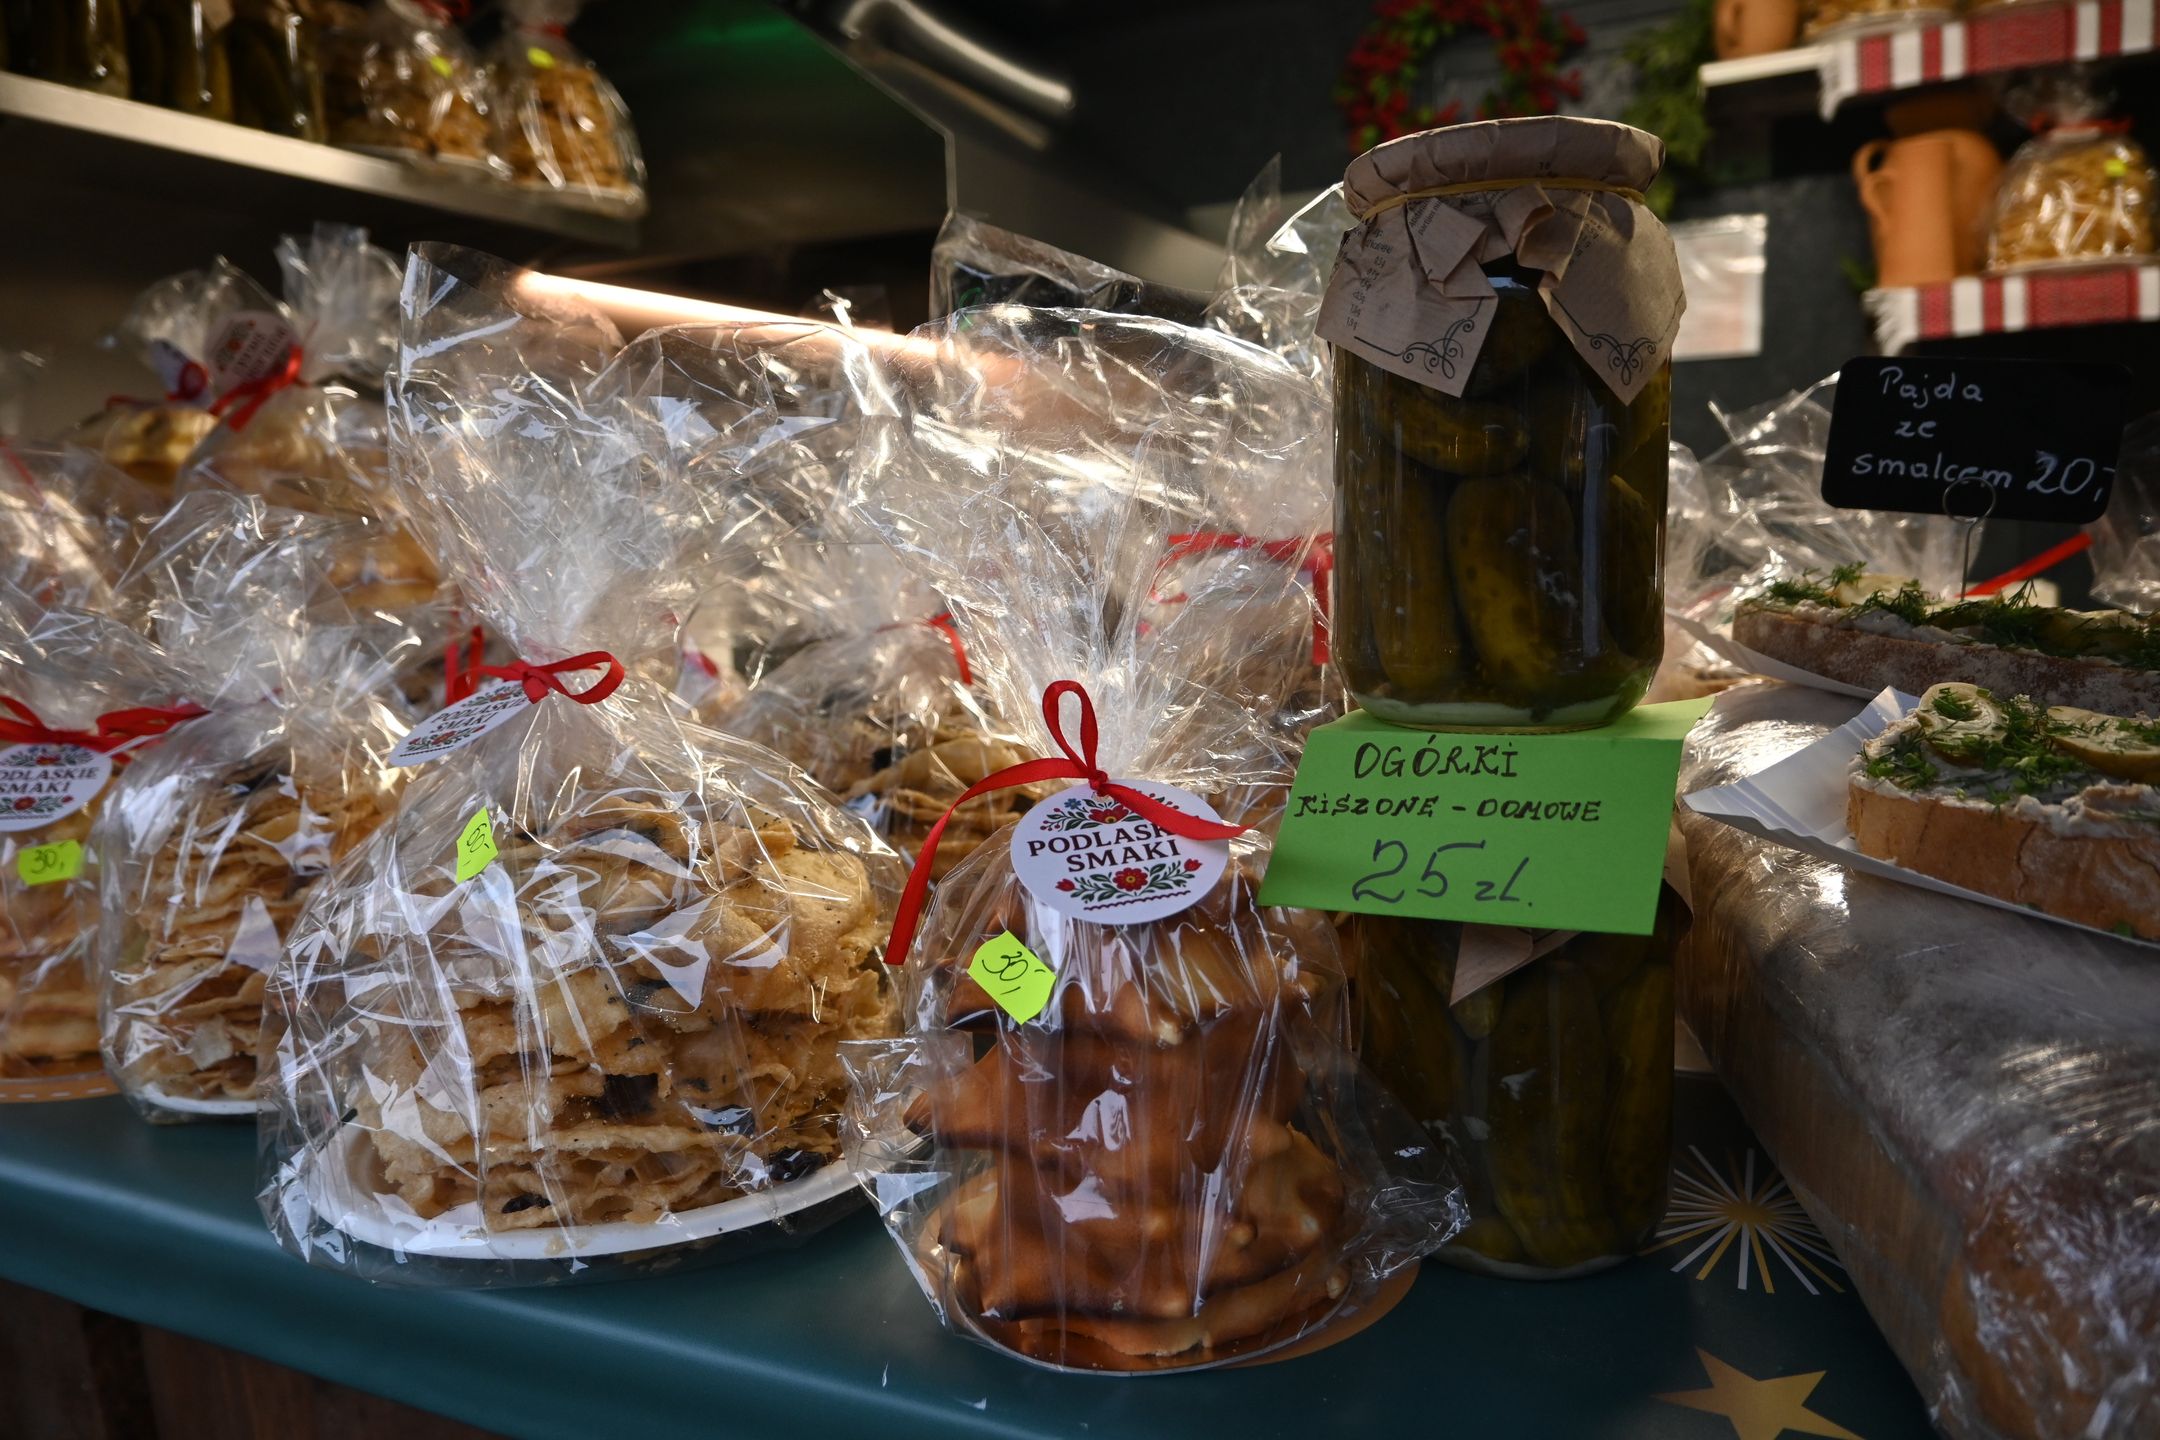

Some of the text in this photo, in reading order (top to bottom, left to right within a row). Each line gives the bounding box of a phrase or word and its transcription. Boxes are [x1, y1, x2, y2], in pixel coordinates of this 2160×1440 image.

[1879, 365, 1984, 409] Pajda
[1894, 418, 1937, 439] ze
[1851, 451, 2013, 489] smalcem
[1353, 734, 1519, 778] OGÓRKI
[1476, 798, 1602, 822] DOMOWE
[1026, 823, 1177, 857] PODLASK
[1066, 839, 1181, 872] SMAKI
[1351, 839, 1486, 904] 25
